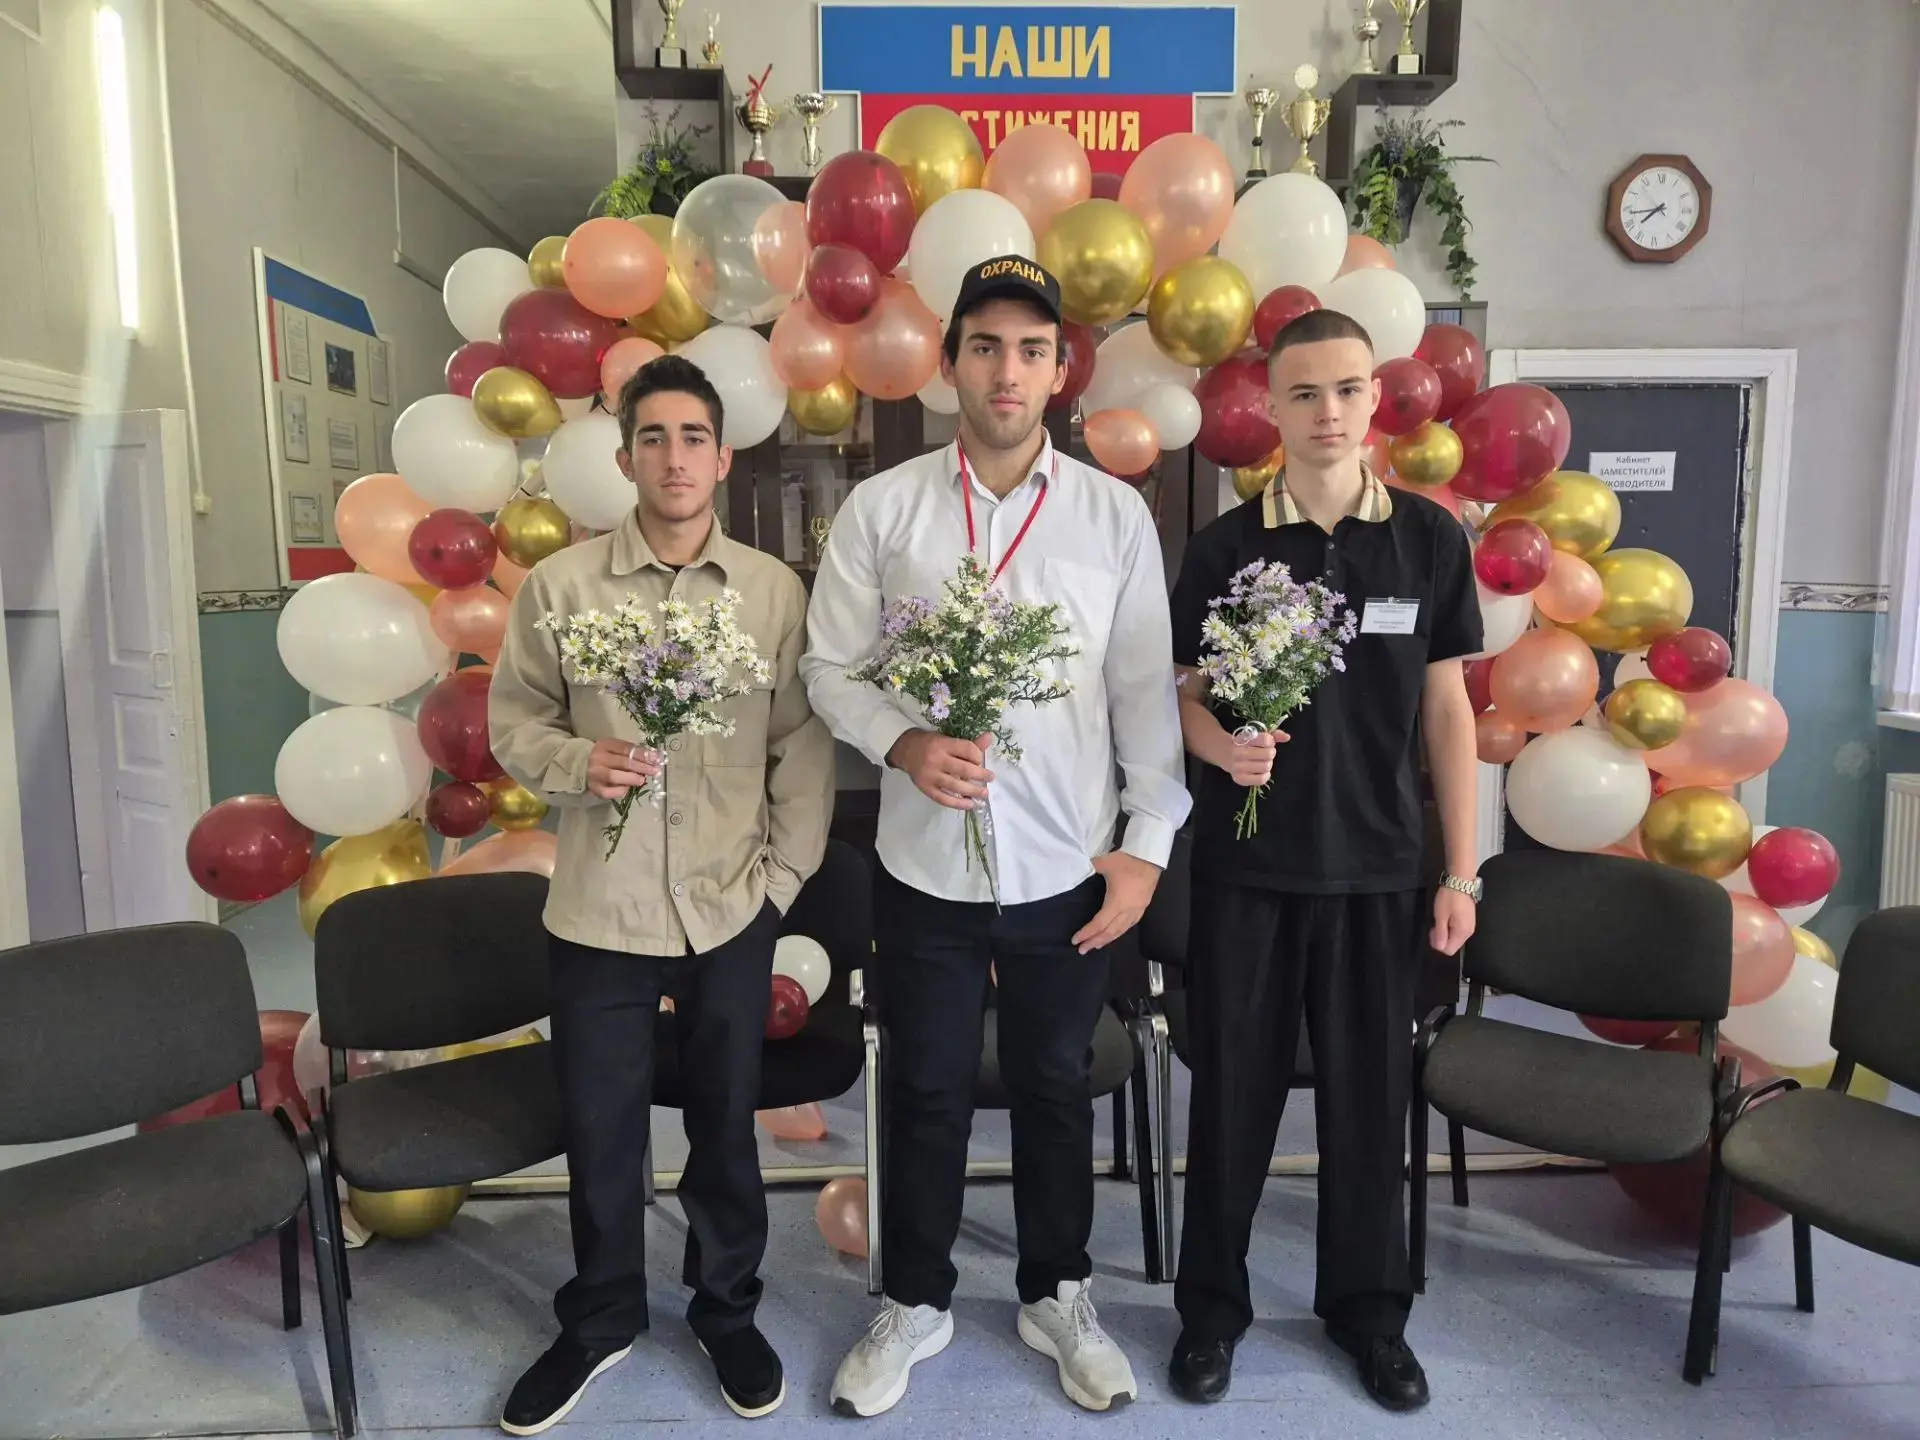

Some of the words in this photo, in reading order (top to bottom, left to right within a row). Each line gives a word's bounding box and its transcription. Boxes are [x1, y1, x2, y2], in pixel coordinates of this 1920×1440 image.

[950, 24, 1110, 78] НАШИ
[980, 260, 1045, 286] ОХРАНА
[1616, 456, 1651, 464] Кабинет
[1602, 480, 1666, 488] УКОВОДИТЕЛЯ
